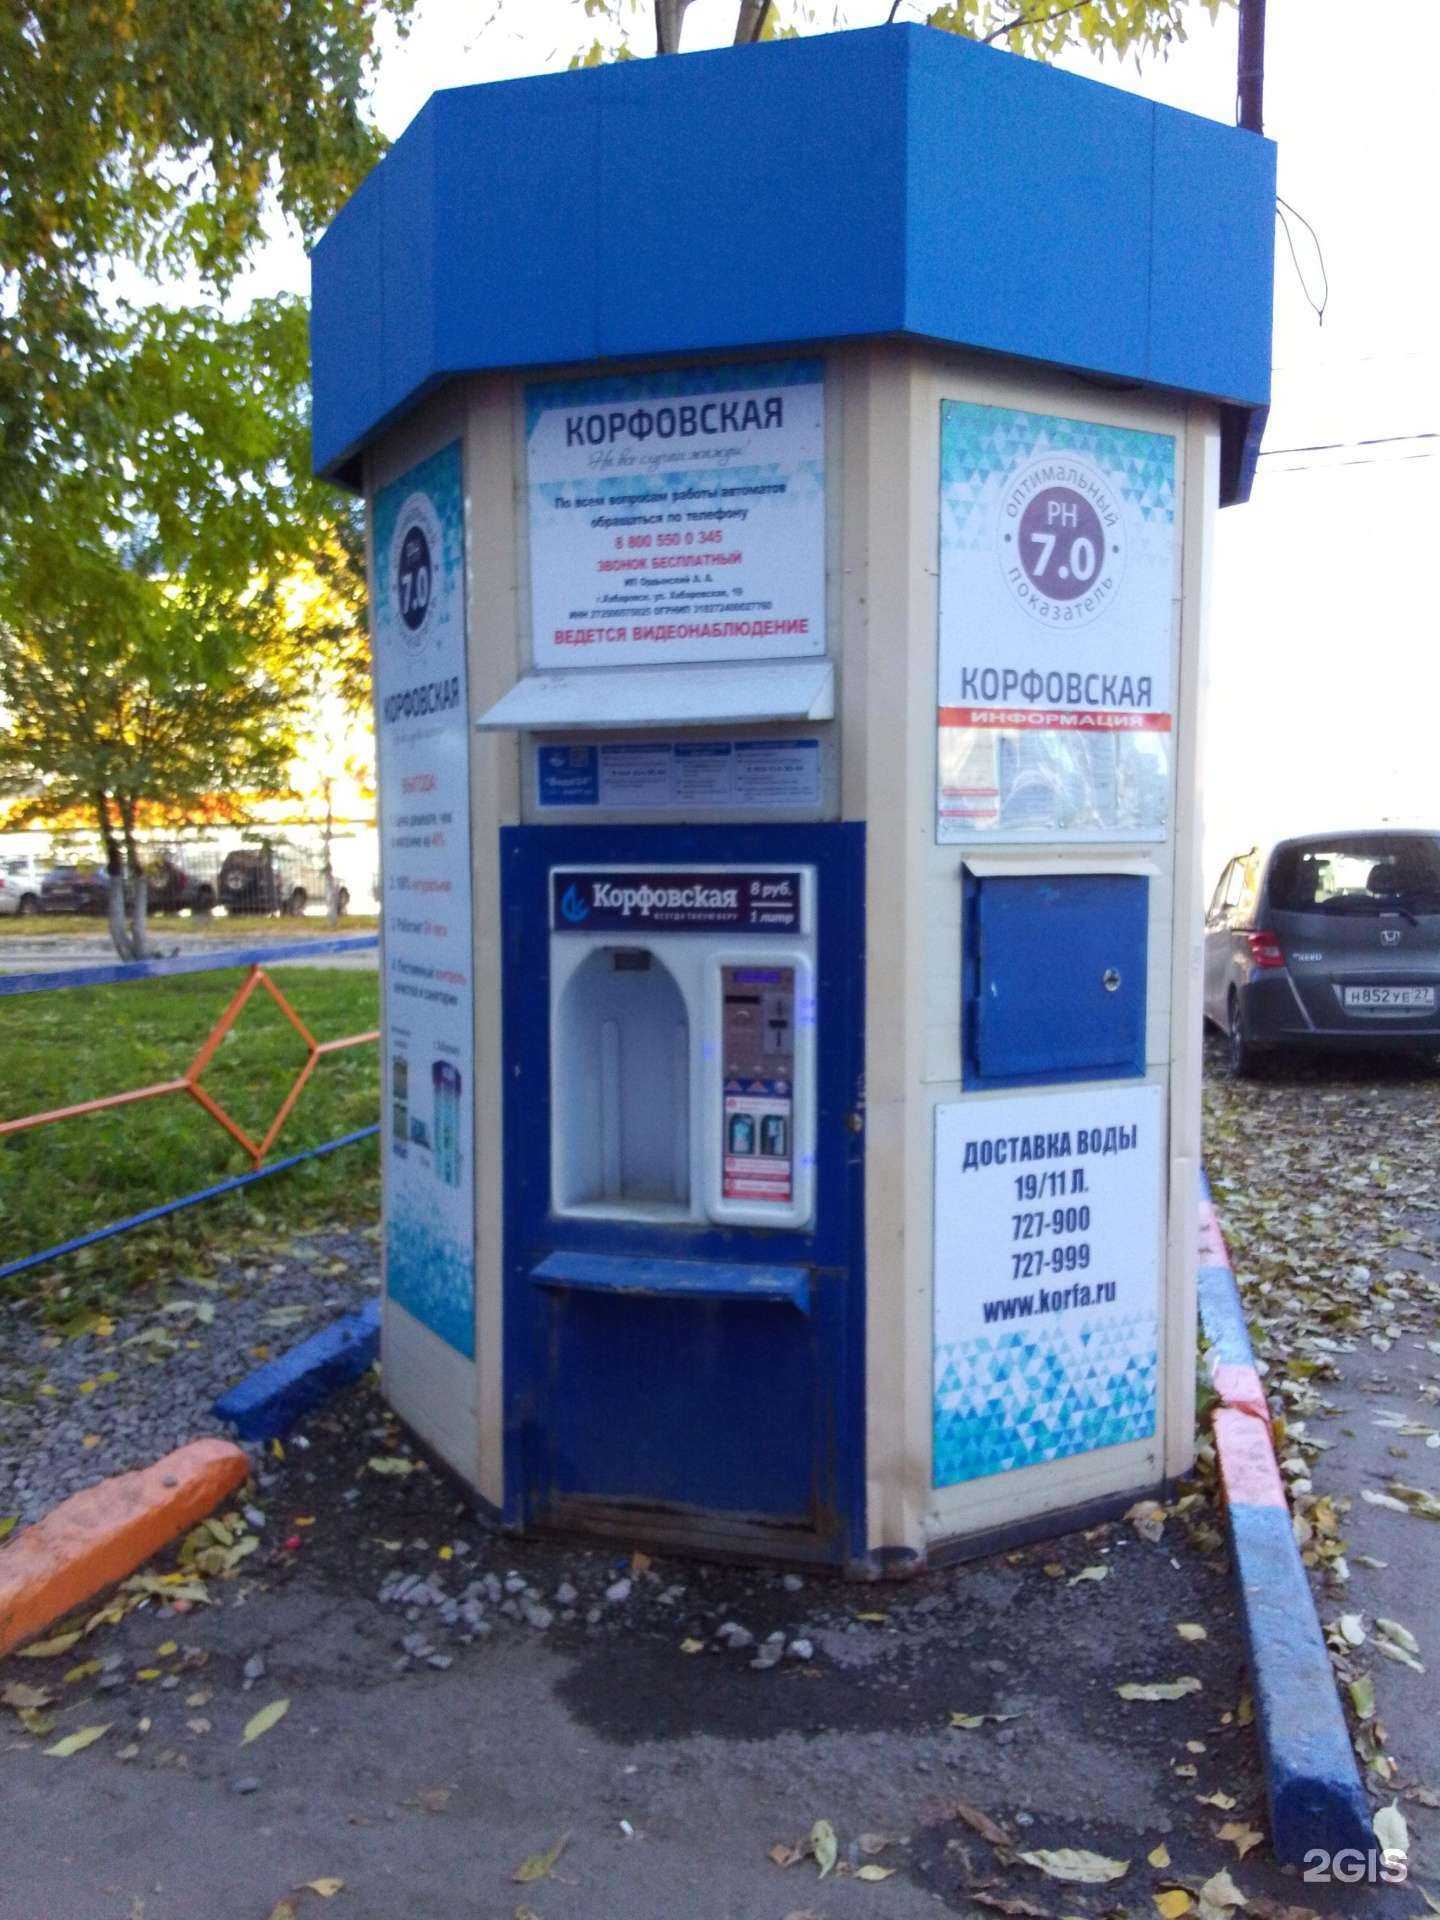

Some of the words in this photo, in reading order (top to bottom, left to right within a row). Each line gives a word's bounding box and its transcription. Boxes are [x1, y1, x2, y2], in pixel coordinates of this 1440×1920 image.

[566, 397, 784, 447] КОРФОВСКАЯ
[609, 492, 668, 507] вопросам
[672, 488, 718, 503] работы
[721, 483, 786, 498] автоматов
[1006, 464, 1119, 529] оптимальный
[590, 514, 663, 529] обращаться
[668, 512, 682, 523] по
[686, 508, 748, 522] телефону
[596, 558, 647, 573] ЗВОНОК
[652, 551, 743, 570] БЕСПЛАТНЫЙ
[1030, 533, 1096, 582] 7.0
[1008, 567, 1115, 621] показатель
[554, 627, 627, 646] ВЕДЕТСЯ
[632, 618, 809, 642] ВИДЕОНАБЛЮДЕНИЕ
[962, 666, 1152, 707] КОРФОВСКАЯ
[970, 711, 1145, 728] ИНФОРМАЦИЯ
[592, 883, 739, 916] Корфовская
[750, 881, 761, 895] 8
[762, 882, 793, 899] руб.
[962, 1131, 1072, 1173] ДОСТАВКА
[1077, 1124, 1138, 1156] ВОДЫ
[1014, 1171, 1067, 1201] 19/11
[1070, 1168, 1090, 1194] Л.
[1011, 1205, 1091, 1241] 727-900
[1011, 1243, 1091, 1280] 727-999
[983, 1281, 1116, 1324] www.korfa.ru
